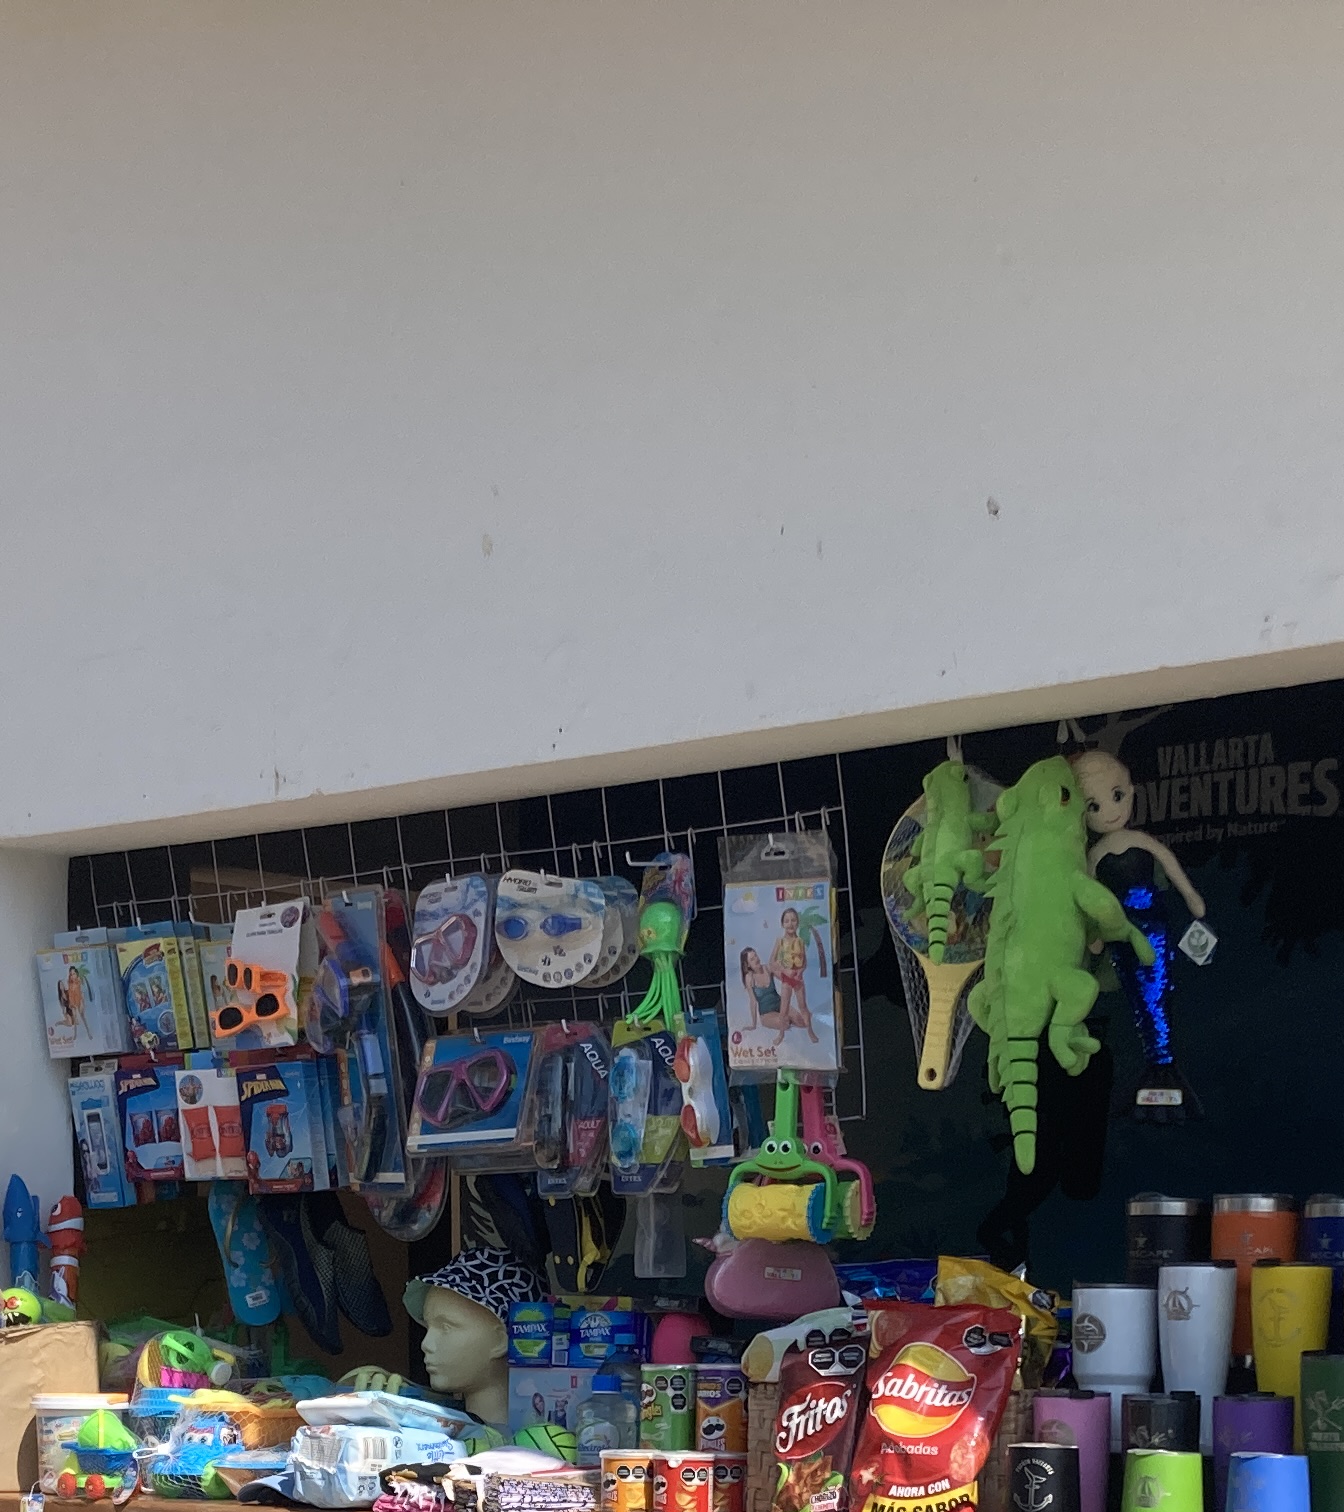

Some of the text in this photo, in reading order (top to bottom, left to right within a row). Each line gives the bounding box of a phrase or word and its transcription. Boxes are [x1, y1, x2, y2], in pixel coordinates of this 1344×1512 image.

[1157, 732, 1274, 777] VALLARTA
[1130, 758, 1340, 826] DVENTURES
[579, 1043, 609, 1080] AQUA
[650, 1037, 676, 1067] AQU
[731, 1045, 777, 1059] Wet Set
[512, 1323, 547, 1335] TAMPAX
[580, 1327, 612, 1339] TAMPAX
[872, 1370, 974, 1408] Sabritas
[775, 1388, 853, 1454] Fritos
[880, 1441, 939, 1455] Adobadas
[888, 1478, 951, 1498] AHORA CON
